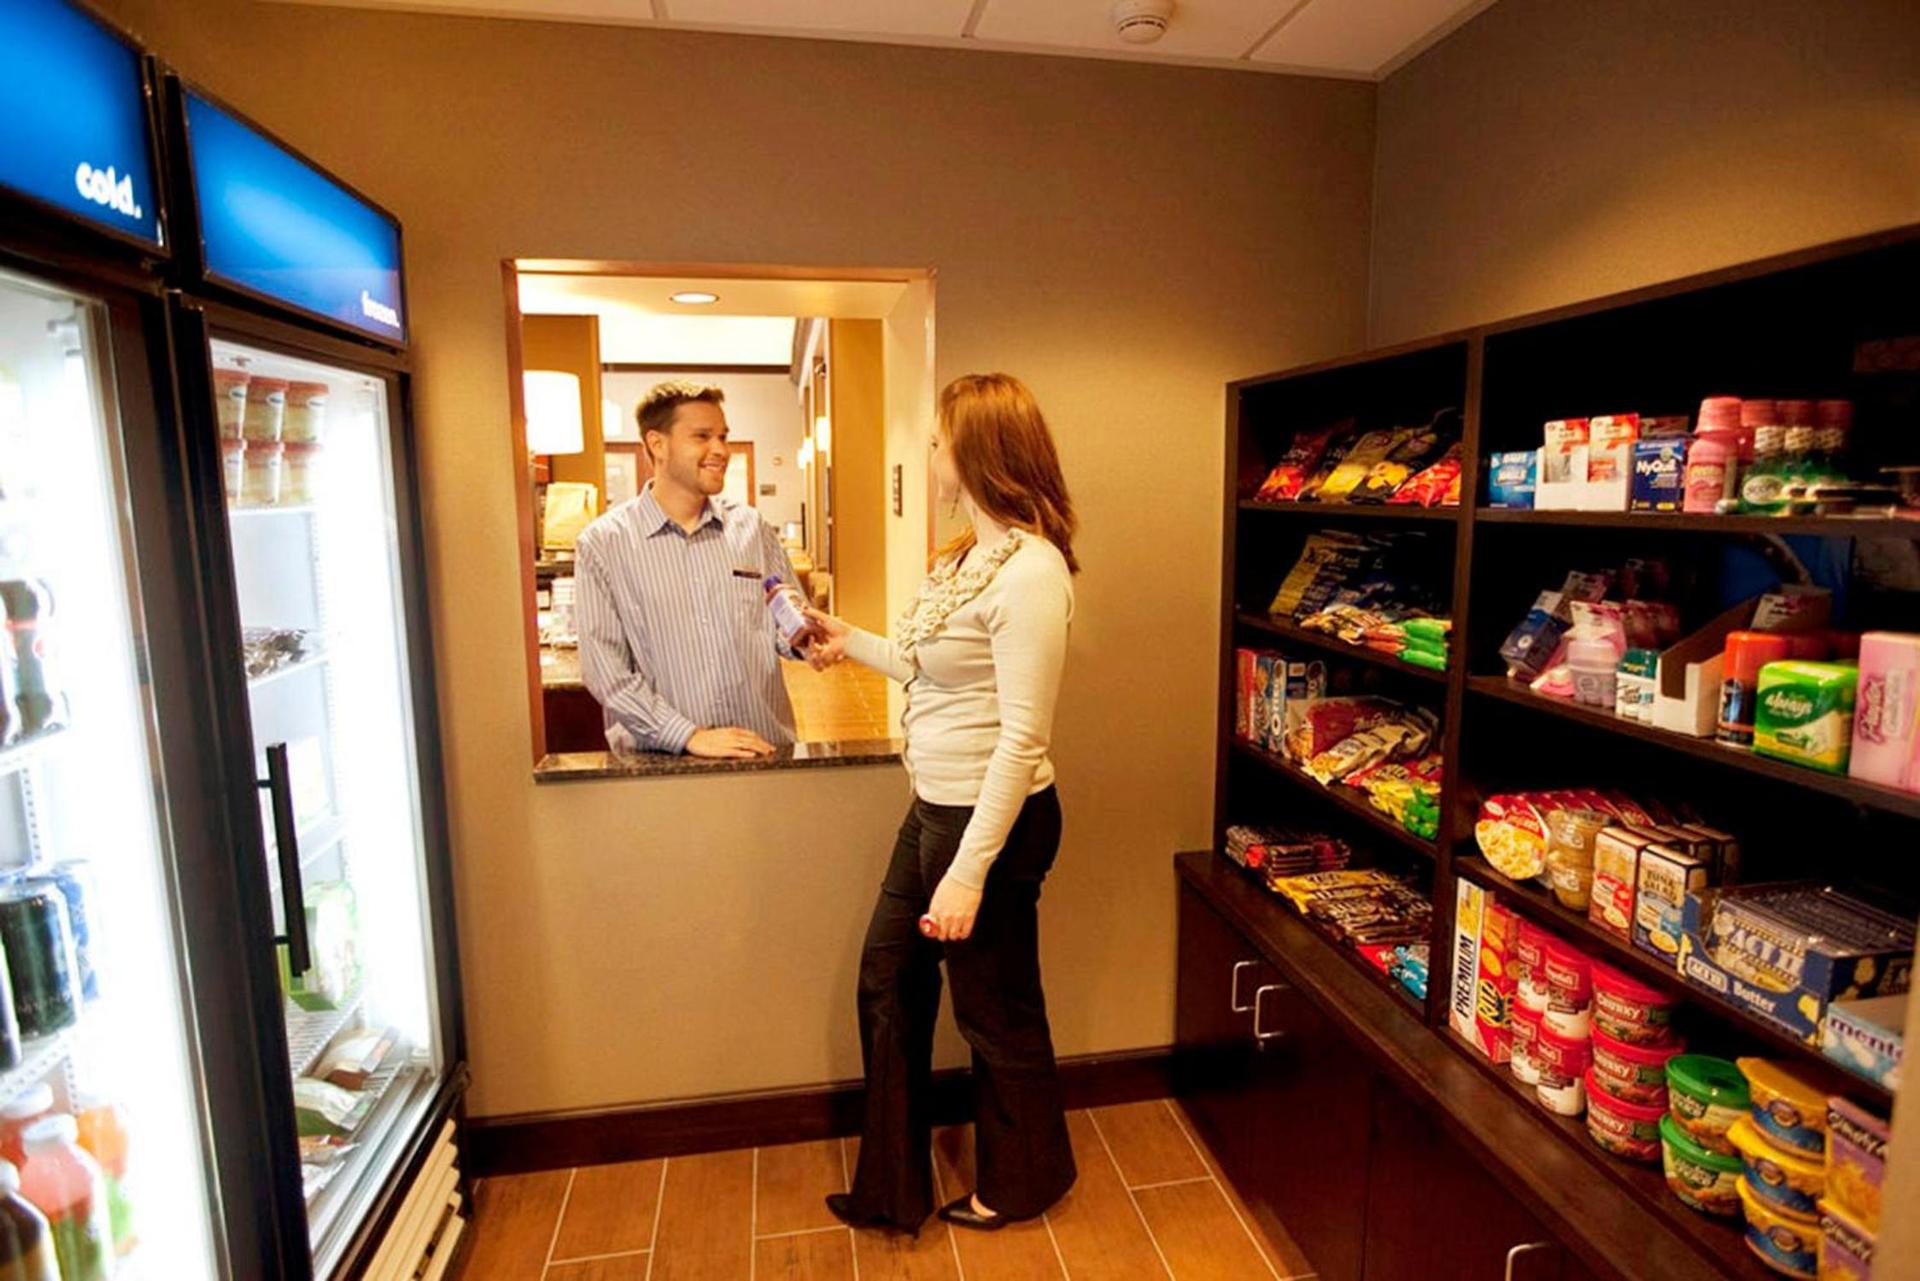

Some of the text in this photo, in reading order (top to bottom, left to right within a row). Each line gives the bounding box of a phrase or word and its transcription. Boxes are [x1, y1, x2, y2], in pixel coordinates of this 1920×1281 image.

[75, 162, 142, 219] cold.
[1455, 934, 1475, 1019] PREMIUM
[1733, 981, 1777, 1013] Butter
